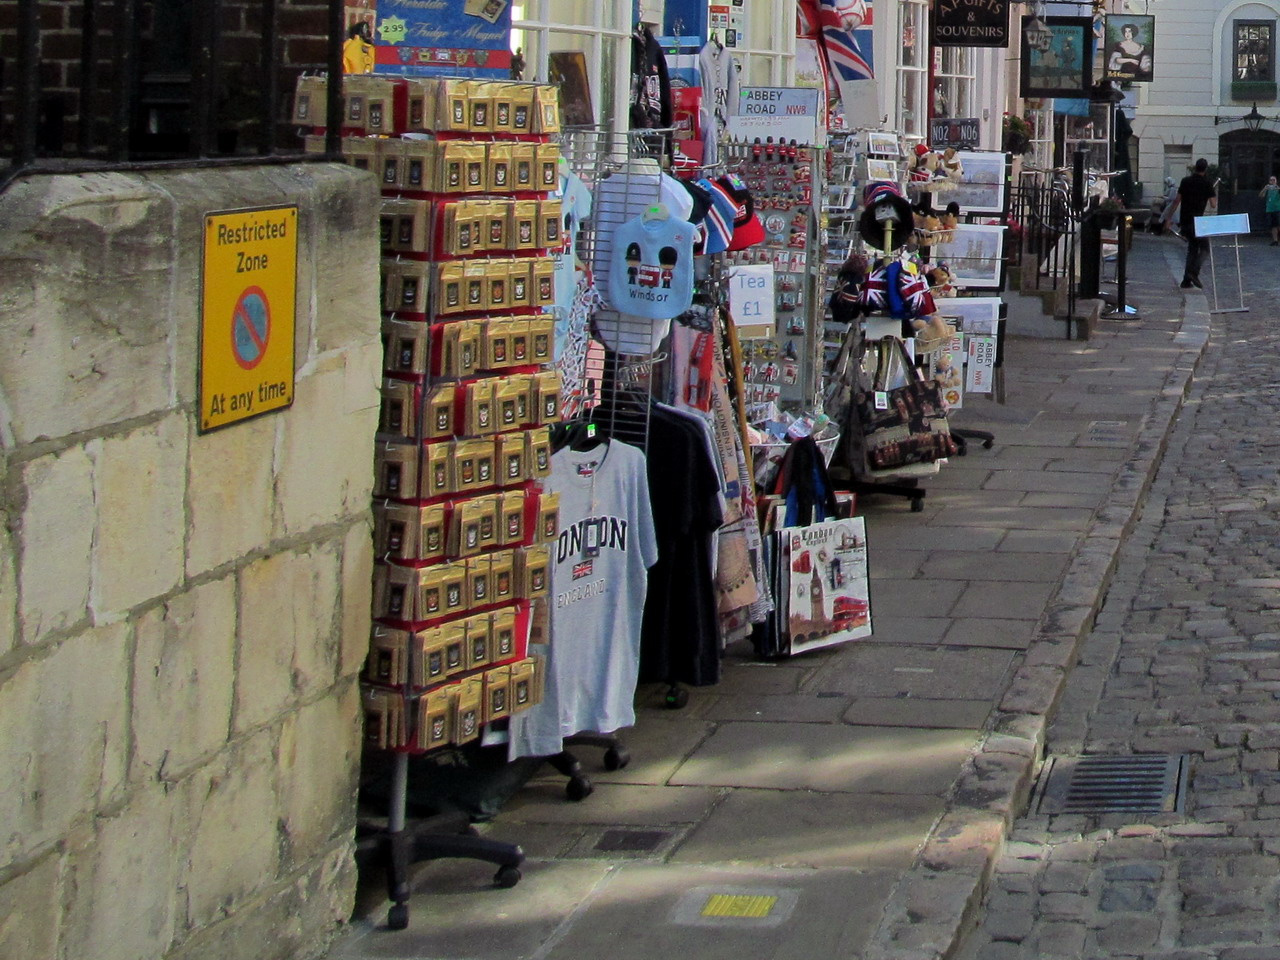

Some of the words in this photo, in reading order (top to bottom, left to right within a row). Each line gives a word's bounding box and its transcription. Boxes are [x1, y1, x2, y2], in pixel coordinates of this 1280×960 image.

[967, 11, 976, 22] &
[410, 21, 449, 43] Fridge
[454, 24, 506, 45] Magnet
[936, 25, 1004, 37] SOUVENIRS
[746, 90, 783, 101] ABBEY
[746, 104, 776, 115] ROAD
[786, 105, 807, 115] NW8
[217, 220, 287, 247] Restricted
[236, 252, 269, 274] Zone
[737, 273, 766, 289] Tea
[629, 288, 669, 302] Windsor
[743, 301, 762, 316] £1
[976, 342, 985, 364] ROAD
[985, 342, 993, 368] ABBEY
[209, 393, 228, 417] At
[230, 390, 254, 413] any
[258, 380, 287, 405] time
[711, 393, 734, 457] KENSINGTON
